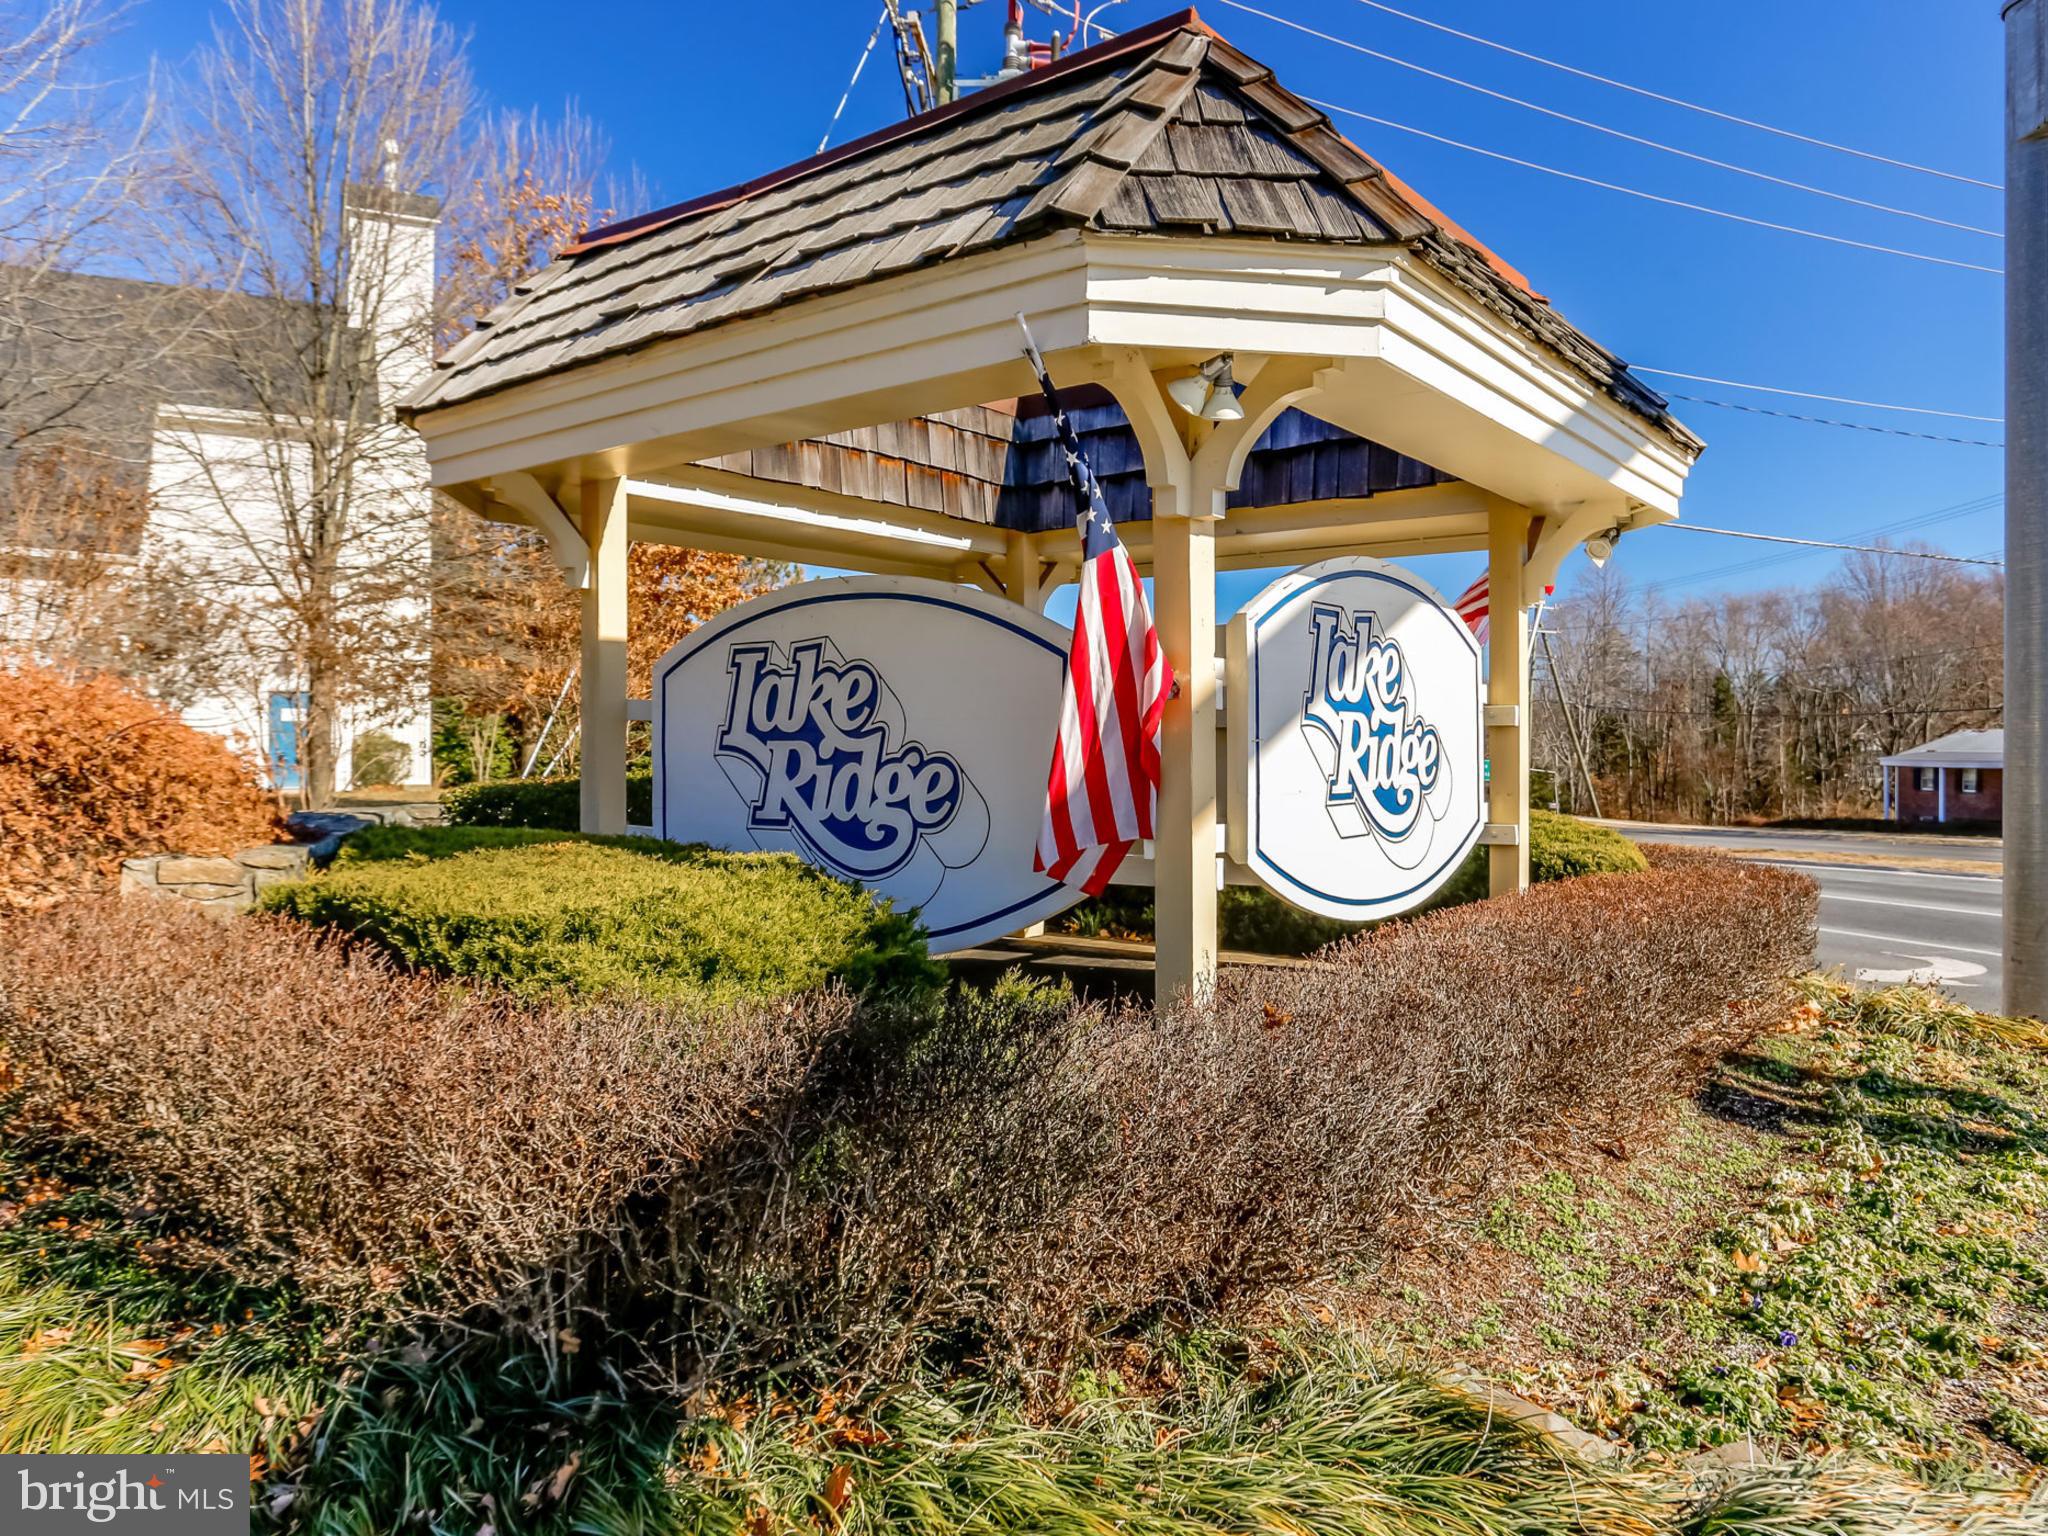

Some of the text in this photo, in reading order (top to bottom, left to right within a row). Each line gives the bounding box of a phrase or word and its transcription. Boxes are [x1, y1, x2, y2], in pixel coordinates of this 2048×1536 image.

[720, 645, 876, 756] Lake
[1305, 612, 1403, 723] Lake
[755, 738, 955, 871] Ridge
[1332, 711, 1440, 836] Ridge
